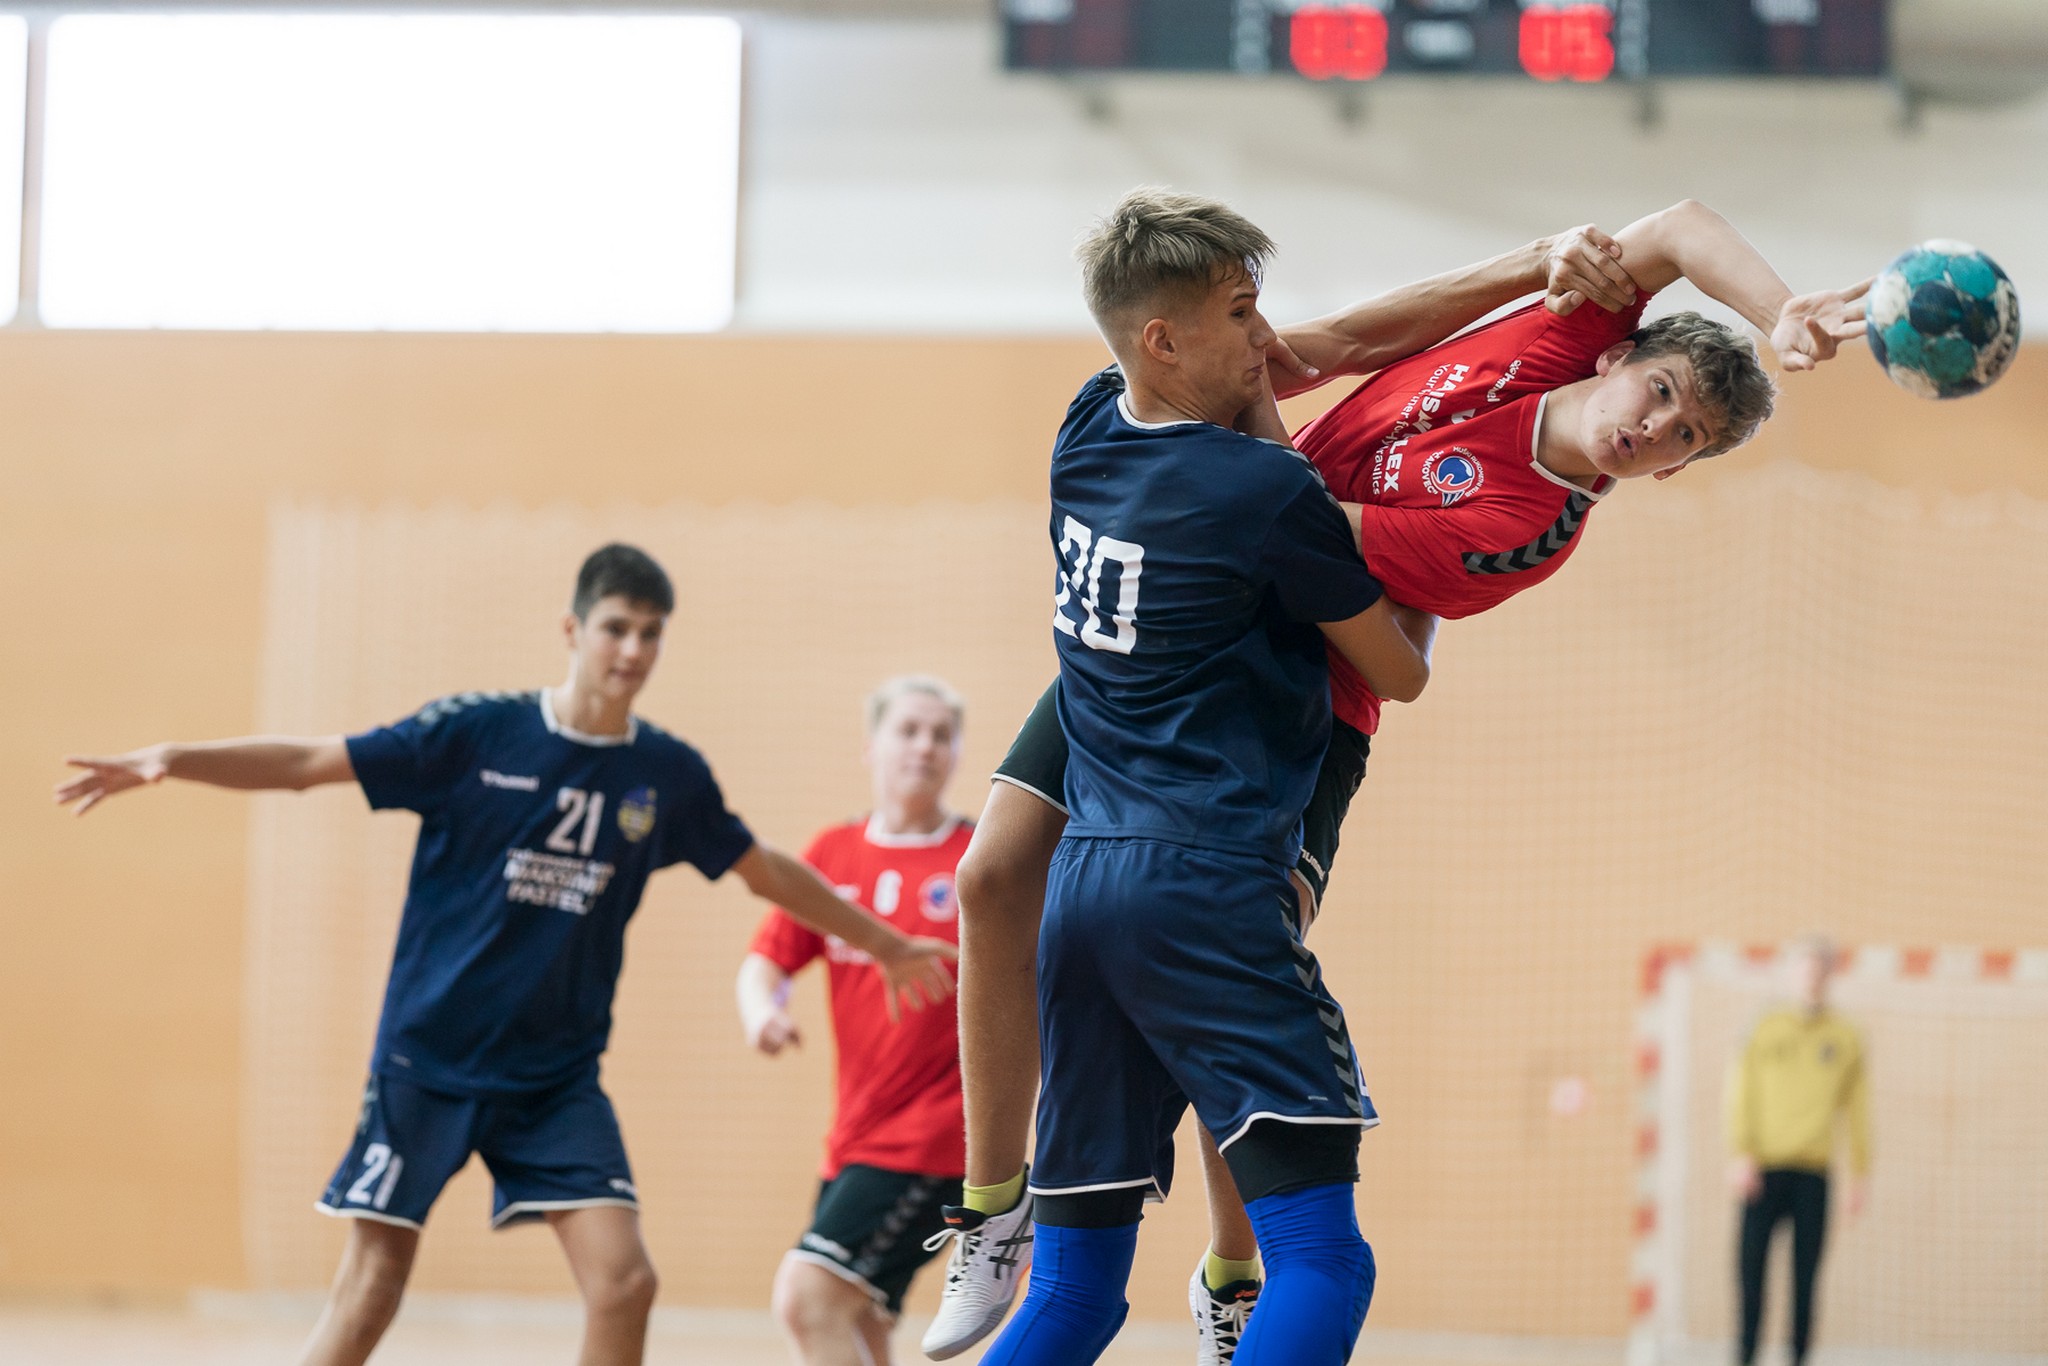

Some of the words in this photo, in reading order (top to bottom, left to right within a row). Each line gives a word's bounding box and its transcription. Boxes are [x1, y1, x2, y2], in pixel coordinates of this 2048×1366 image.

[1426, 363, 1452, 391] Your
[1053, 514, 1145, 655] 20
[545, 786, 605, 856] 21
[346, 1143, 404, 1211] 21
